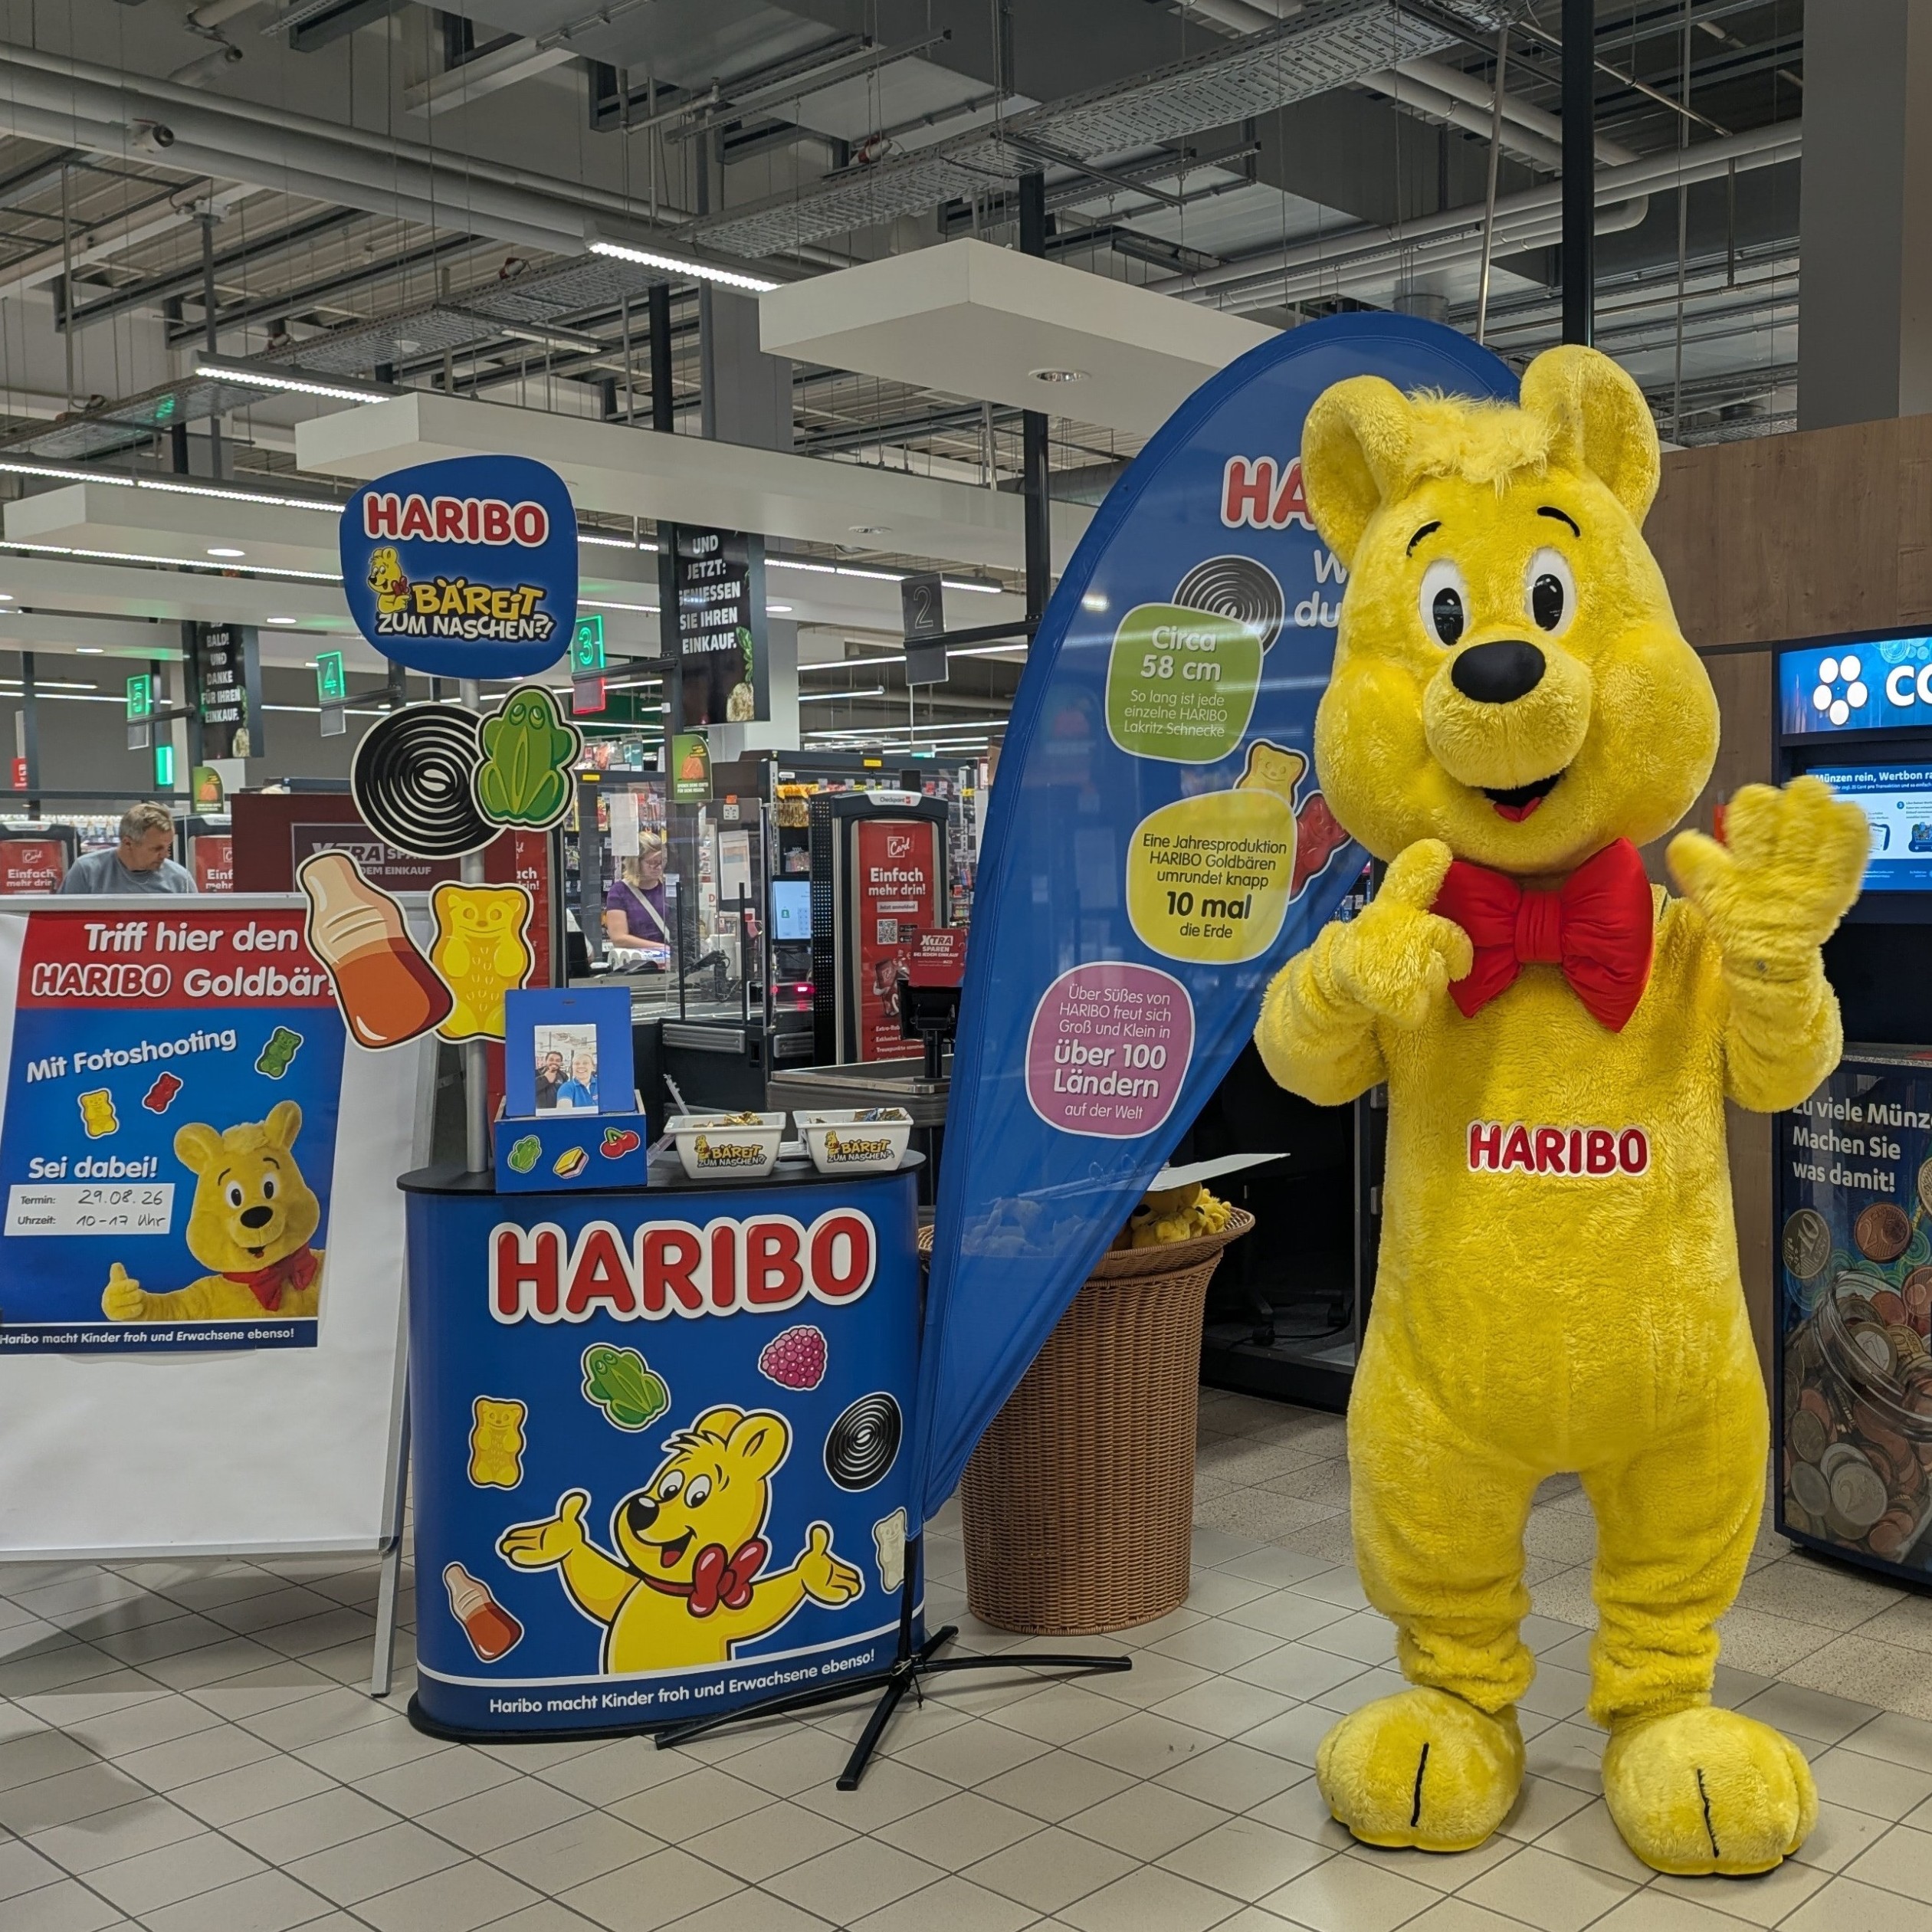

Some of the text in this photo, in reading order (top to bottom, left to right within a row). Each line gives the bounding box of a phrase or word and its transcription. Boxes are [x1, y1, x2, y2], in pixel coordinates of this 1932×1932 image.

[1225, 460, 1315, 526] HA
[366, 494, 546, 545] HARIBO
[693, 535, 719, 554] UND
[687, 559, 727, 580] JETZT:
[914, 586, 933, 629] 2
[378, 613, 554, 640] ZUM NASCHEN?!
[680, 606, 738, 631] SIE IHREN
[206, 632, 230, 648] BALD!
[579, 627, 594, 665] 3
[683, 632, 737, 654] EINKAUF.
[1151, 625, 1217, 653] Circa
[210, 652, 228, 666] UND
[1140, 655, 1222, 681] 58 cm
[207, 670, 234, 685] DANKE
[324, 661, 337, 694] 4
[201, 688, 241, 704] FÜR IHREN
[1130, 690, 1225, 708] So lang ist jede
[205, 708, 240, 723] EINKAUF.
[1124, 707, 1228, 722] einzelne HARIBO
[1123, 720, 1225, 738] Lakritz Schnecke
[1855, 772, 1877, 782] rein,
[1879, 770, 1922, 781] Wertbon
[1143, 833, 1287, 854] Eine Jahresproduktion
[385, 866, 432, 876] EINKAUF
[1150, 851, 1277, 871] HARIBO Goldbären
[6, 879, 31, 887] mehr
[8, 868, 54, 878] Einfach
[870, 867, 923, 882] Einfach
[1156, 871, 1269, 890] umrundet knapp
[868, 884, 926, 896] mehr drin!
[1166, 891, 1252, 920] 10 mal
[84, 921, 299, 952] Triff hier den
[920, 934, 953, 946] XTRA
[1180, 923, 1233, 938] die Erde
[31, 963, 172, 997] HARIBO
[1069, 982, 1170, 1005] Über Süßes von
[1059, 1002, 1172, 1022] HARIBO freut sich
[1059, 1019, 1170, 1038] Groß und Klein in
[26, 1028, 237, 1084] Mit Fotoshooting
[1055, 1038, 1167, 1070] über 100
[1054, 1068, 1159, 1097] Ländern
[1064, 1103, 1143, 1120] auf der Welt
[1816, 1097, 1863, 1123] viele
[1468, 1122, 1649, 1176] HARIBO
[1793, 1126, 1901, 1160] Machen Sie
[28, 1156, 158, 1179] Sei dabei!
[698, 1159, 718, 1167] ZUM
[828, 1153, 848, 1163] ZUM
[1793, 1162, 1895, 1193] was damit!
[21, 1196, 56, 1205] Termin:
[18, 1215, 57, 1225] Uhrzeit:
[137, 1214, 166, 1227] Uhr
[494, 1212, 873, 1318] HARIBO
[0, 1327, 295, 1346] Haribo macht Kinder froh und Erwachsene ebenso!
[489, 1648, 876, 1714] Haribo macht Kinder froh und Erwachsene ebenso!
